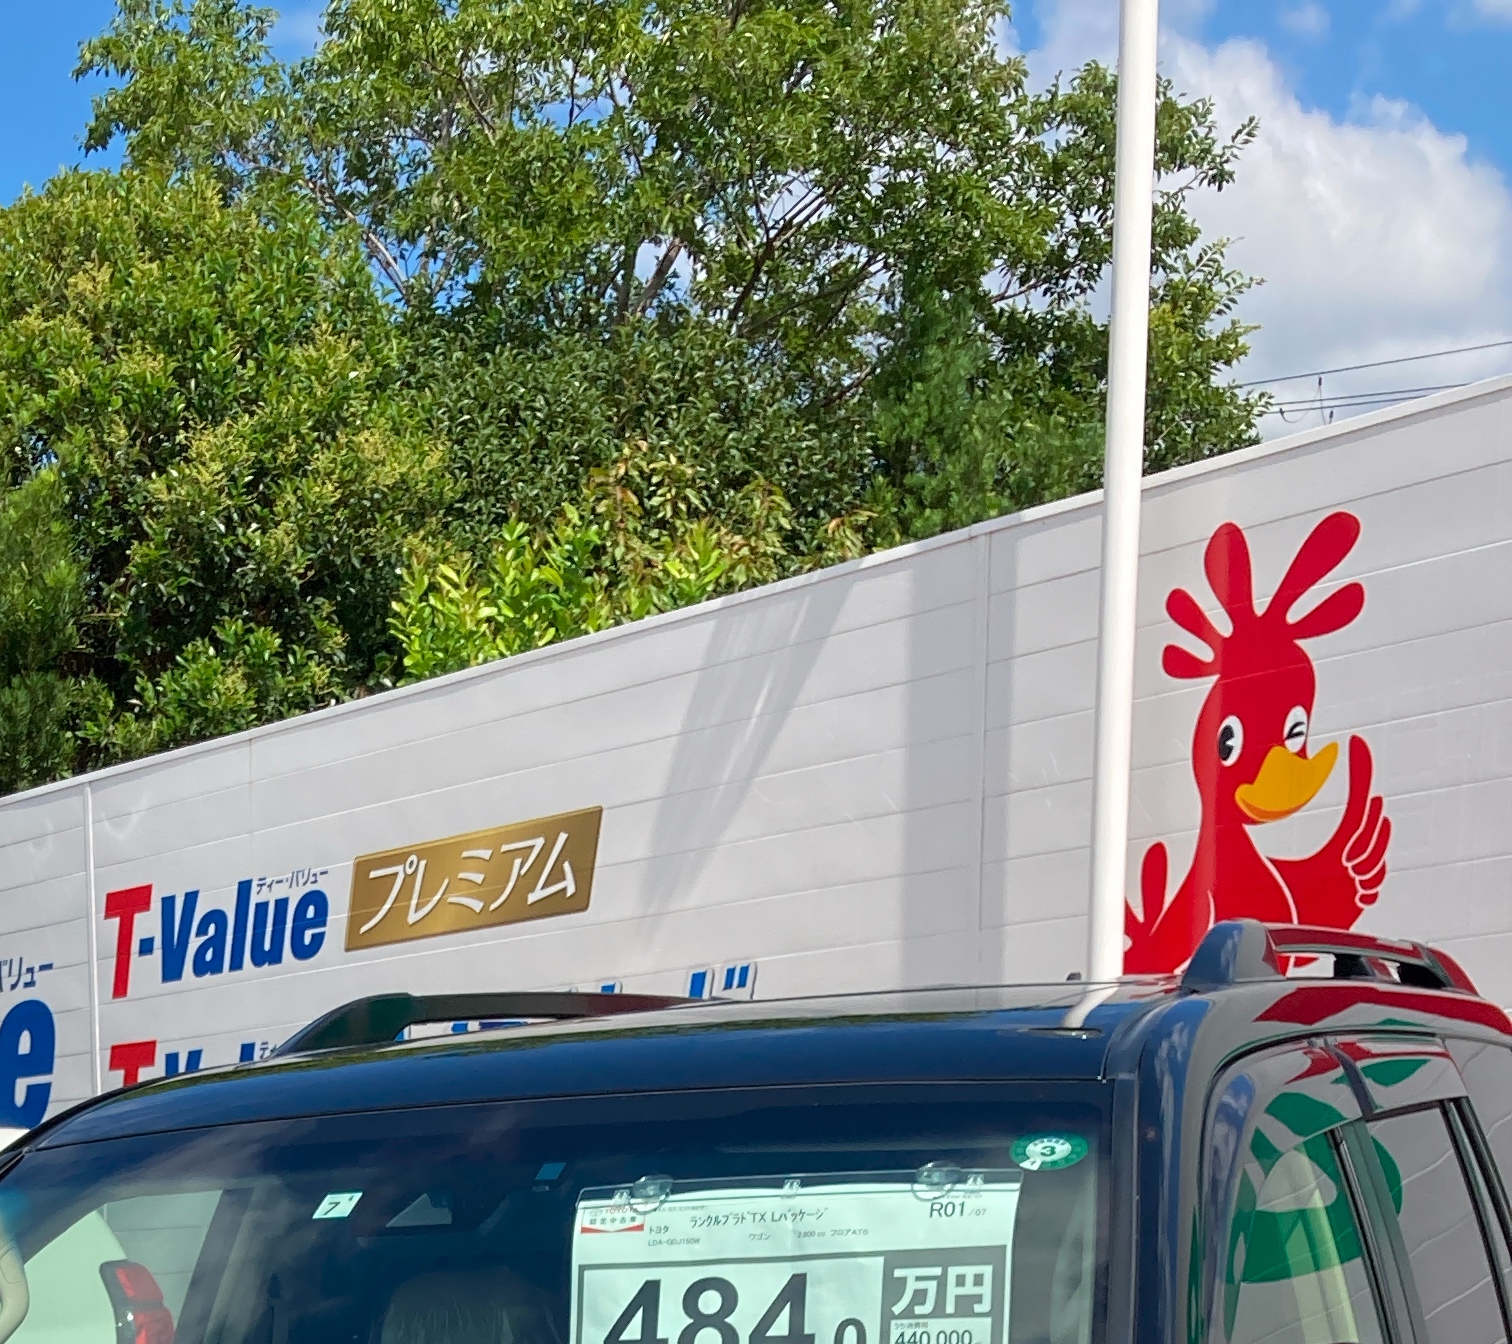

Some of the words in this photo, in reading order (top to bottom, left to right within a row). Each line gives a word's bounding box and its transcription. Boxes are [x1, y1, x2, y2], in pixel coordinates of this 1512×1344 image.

[255, 867, 329, 895] ティー・バリュー
[359, 831, 576, 934] プレミアム
[104, 879, 328, 999] T-Value
[1040, 1146, 1056, 1157] 3
[323, 1201, 341, 1216] 7
[649, 1225, 669, 1235] トヨタ
[748, 1232, 772, 1241] ワゴン
[891, 1264, 993, 1315] 万円
